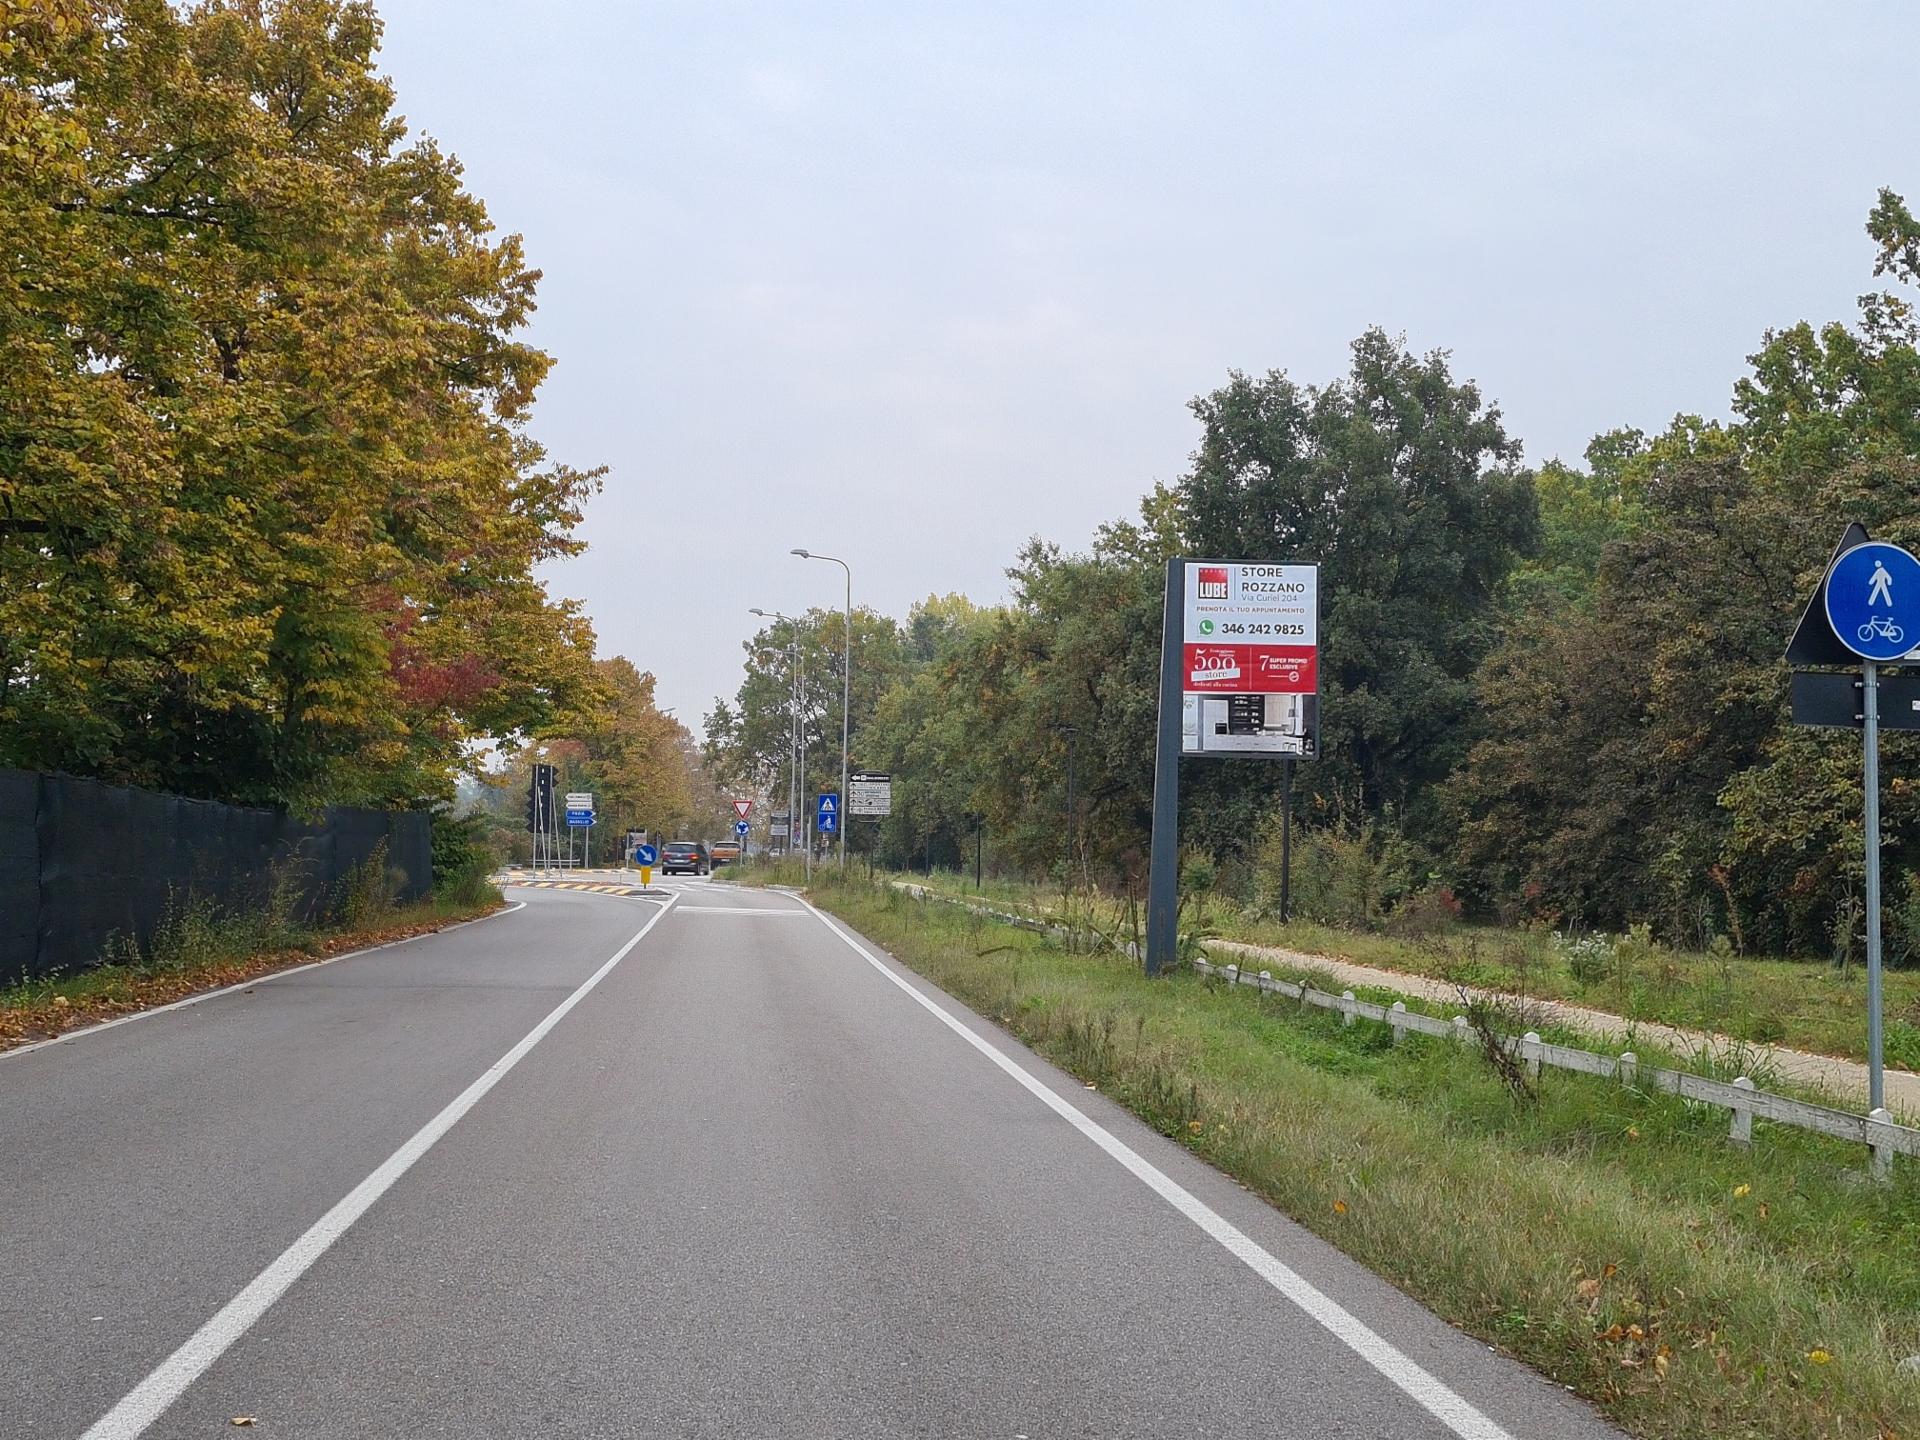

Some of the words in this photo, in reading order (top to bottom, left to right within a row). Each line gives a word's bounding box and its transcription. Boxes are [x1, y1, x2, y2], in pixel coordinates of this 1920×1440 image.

[1241, 567, 1283, 577] STORE
[1199, 582, 1227, 598] LUBE
[1241, 582, 1305, 593] ROZZANO
[1241, 594, 1254, 602] Via
[1256, 594, 1280, 602] Curiel
[1222, 624, 1245, 634] 346
[1248, 624, 1271, 634] 242
[1274, 624, 1305, 635] 9825
[1194, 648, 1236, 670] 500
[1259, 654, 1270, 671] 7
[1205, 671, 1228, 679] store
